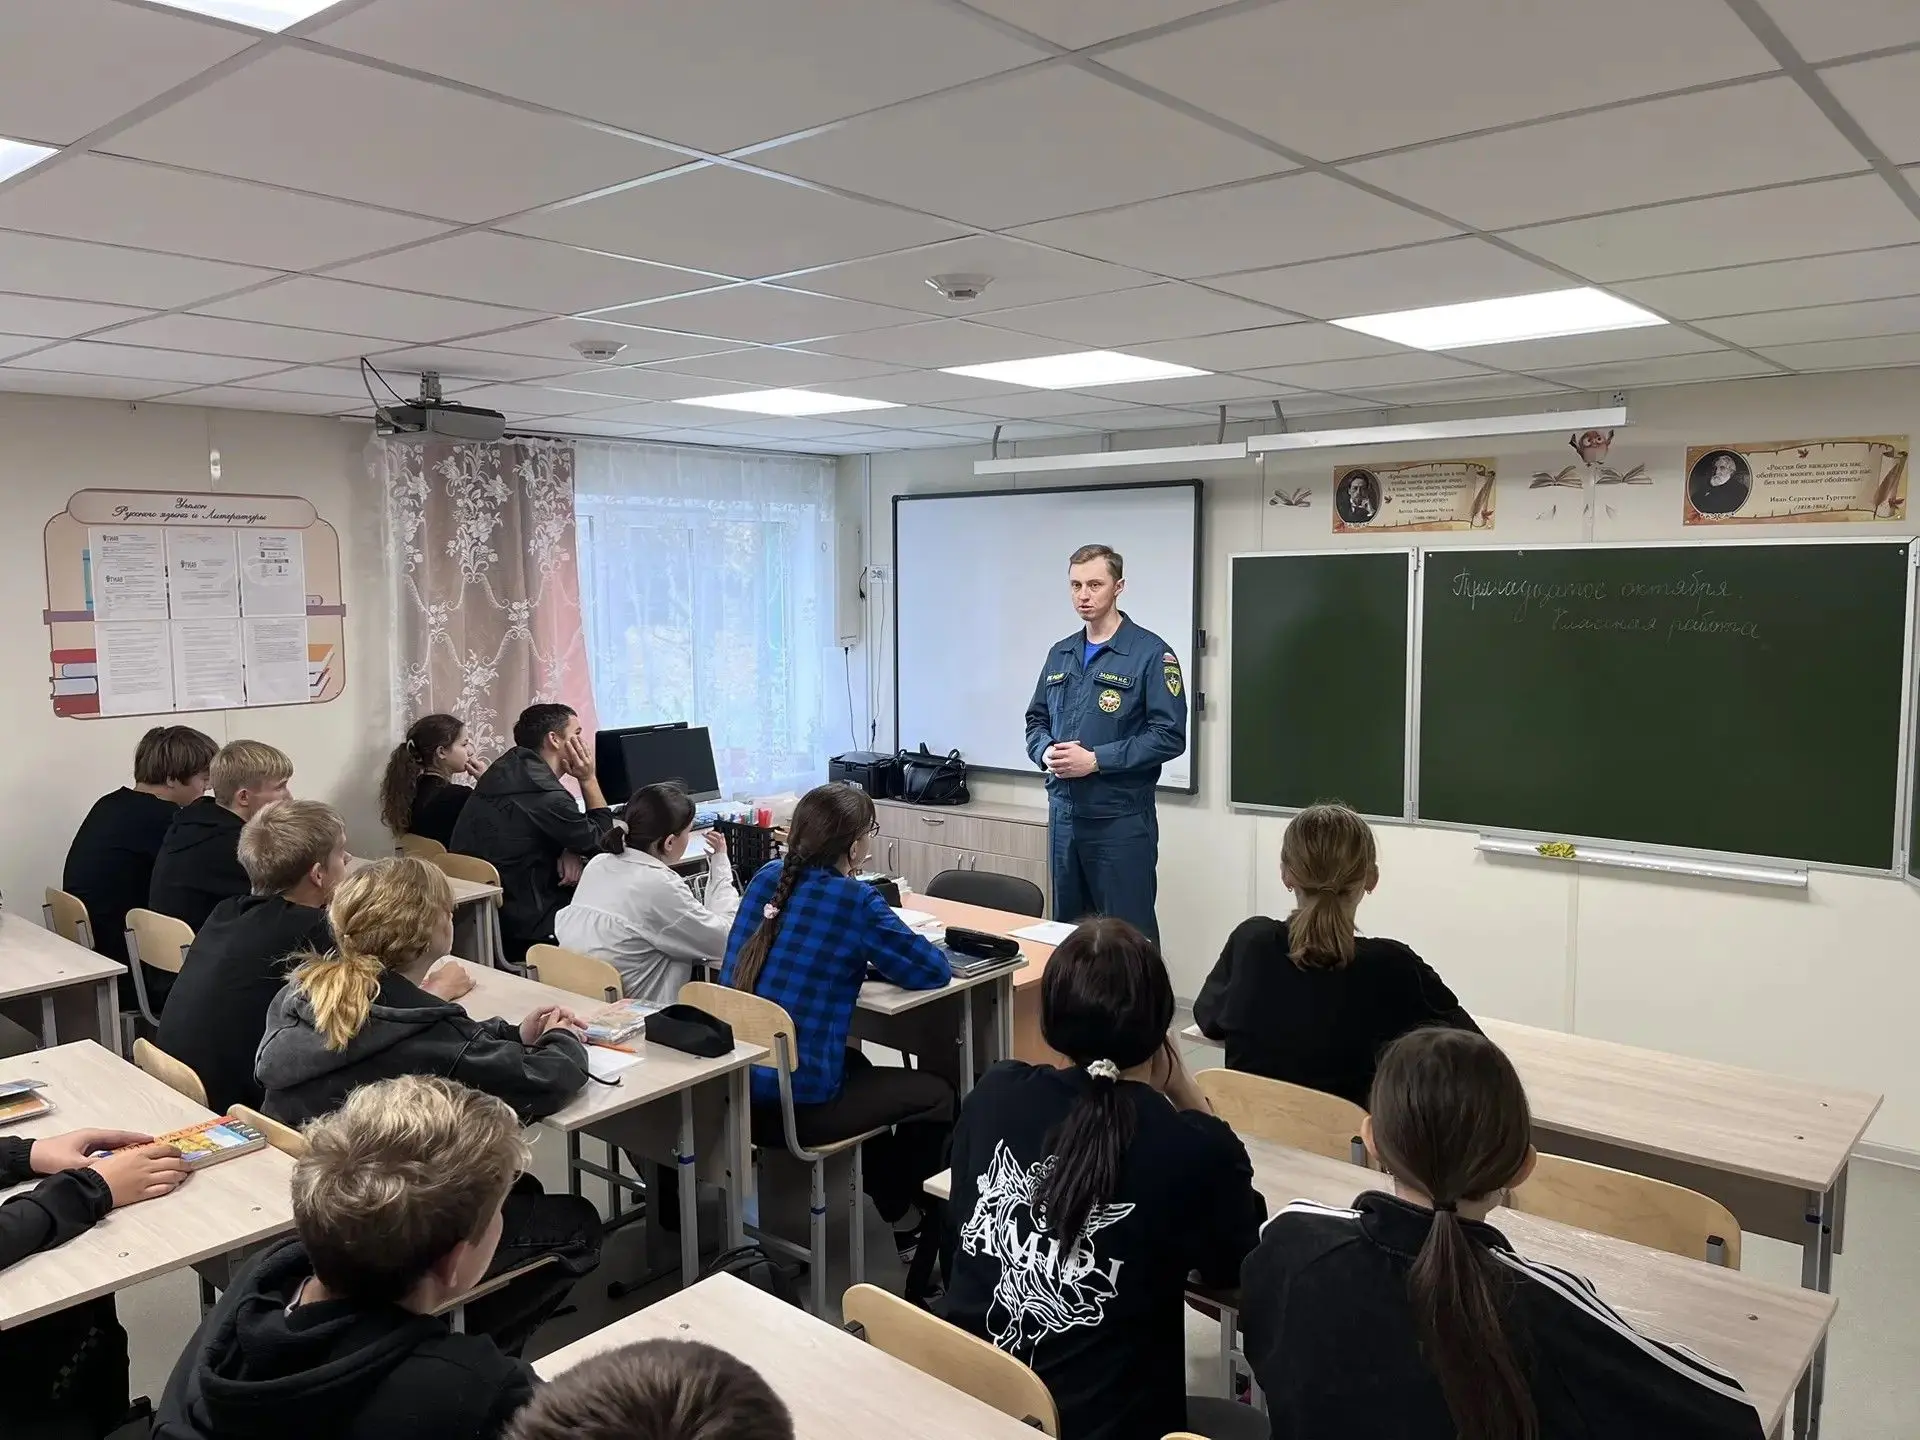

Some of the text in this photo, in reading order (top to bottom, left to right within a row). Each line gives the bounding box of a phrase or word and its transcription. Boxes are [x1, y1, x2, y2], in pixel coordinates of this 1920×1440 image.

[175, 497, 208, 509] Уголок
[112, 505, 158, 520] Русского
[160, 511, 189, 522] языка
[202, 509, 267, 524] Литературы
[1666, 610, 1760, 645] работа
